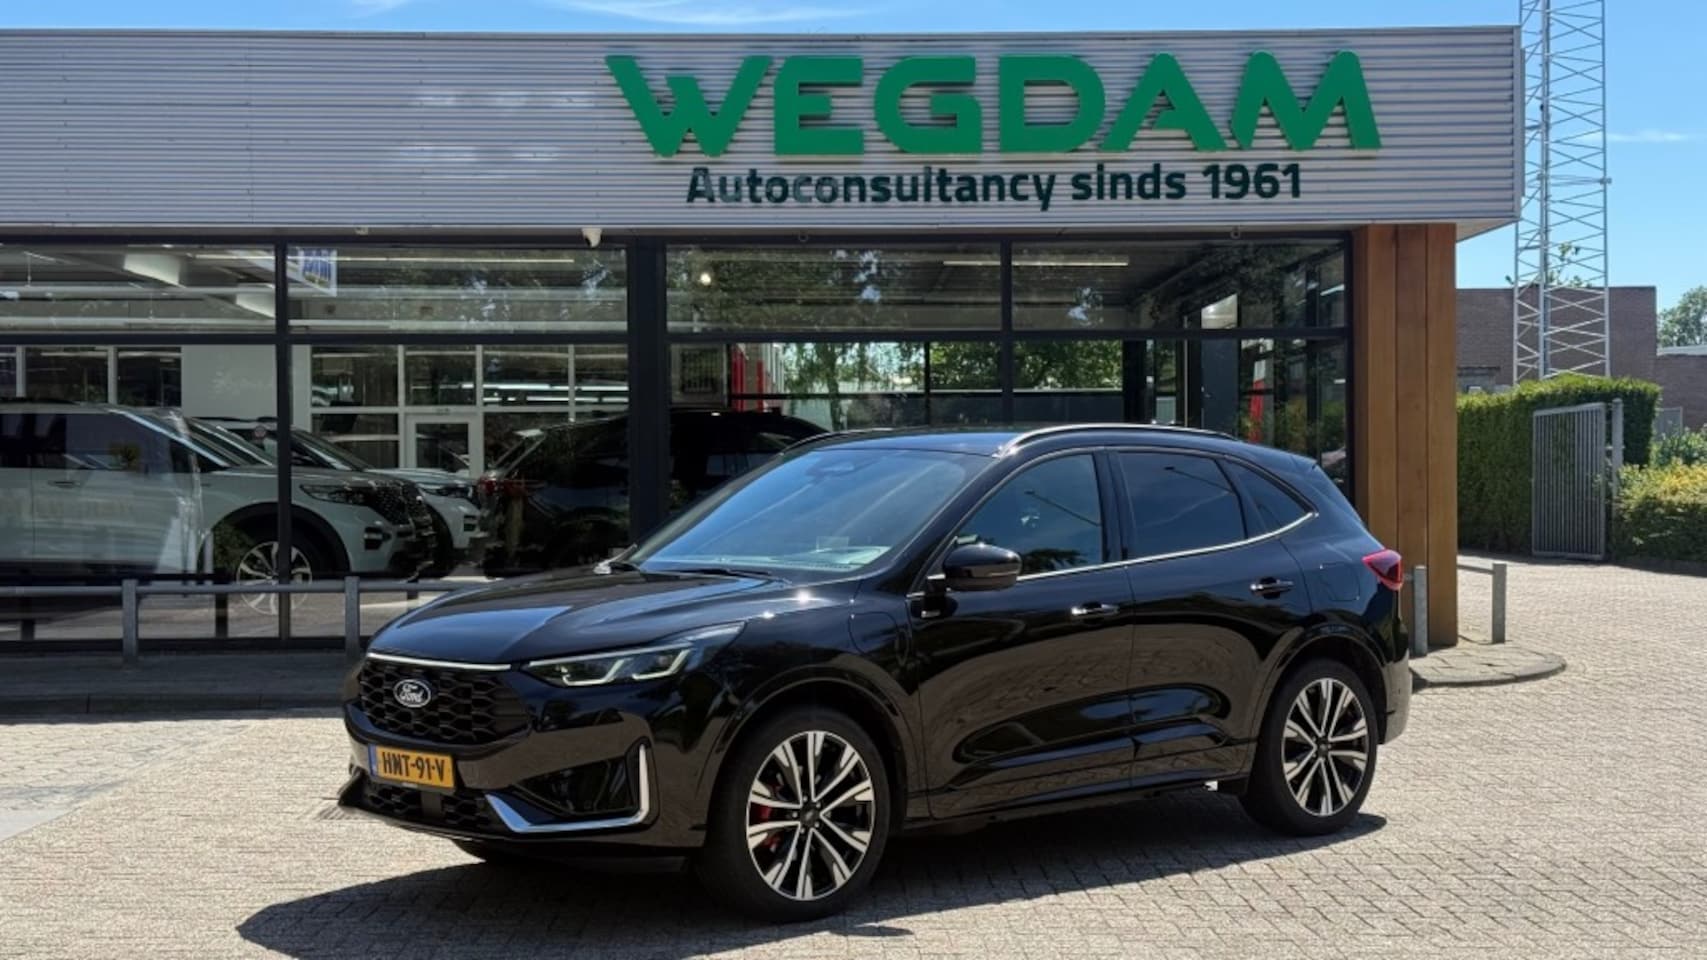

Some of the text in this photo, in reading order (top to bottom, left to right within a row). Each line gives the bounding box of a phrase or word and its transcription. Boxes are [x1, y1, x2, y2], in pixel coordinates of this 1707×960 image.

[606, 51, 1382, 157] WEGDAM
[687, 163, 1301, 212] Autoconsultancy sinds 1961
[399, 683, 424, 703] Ford
